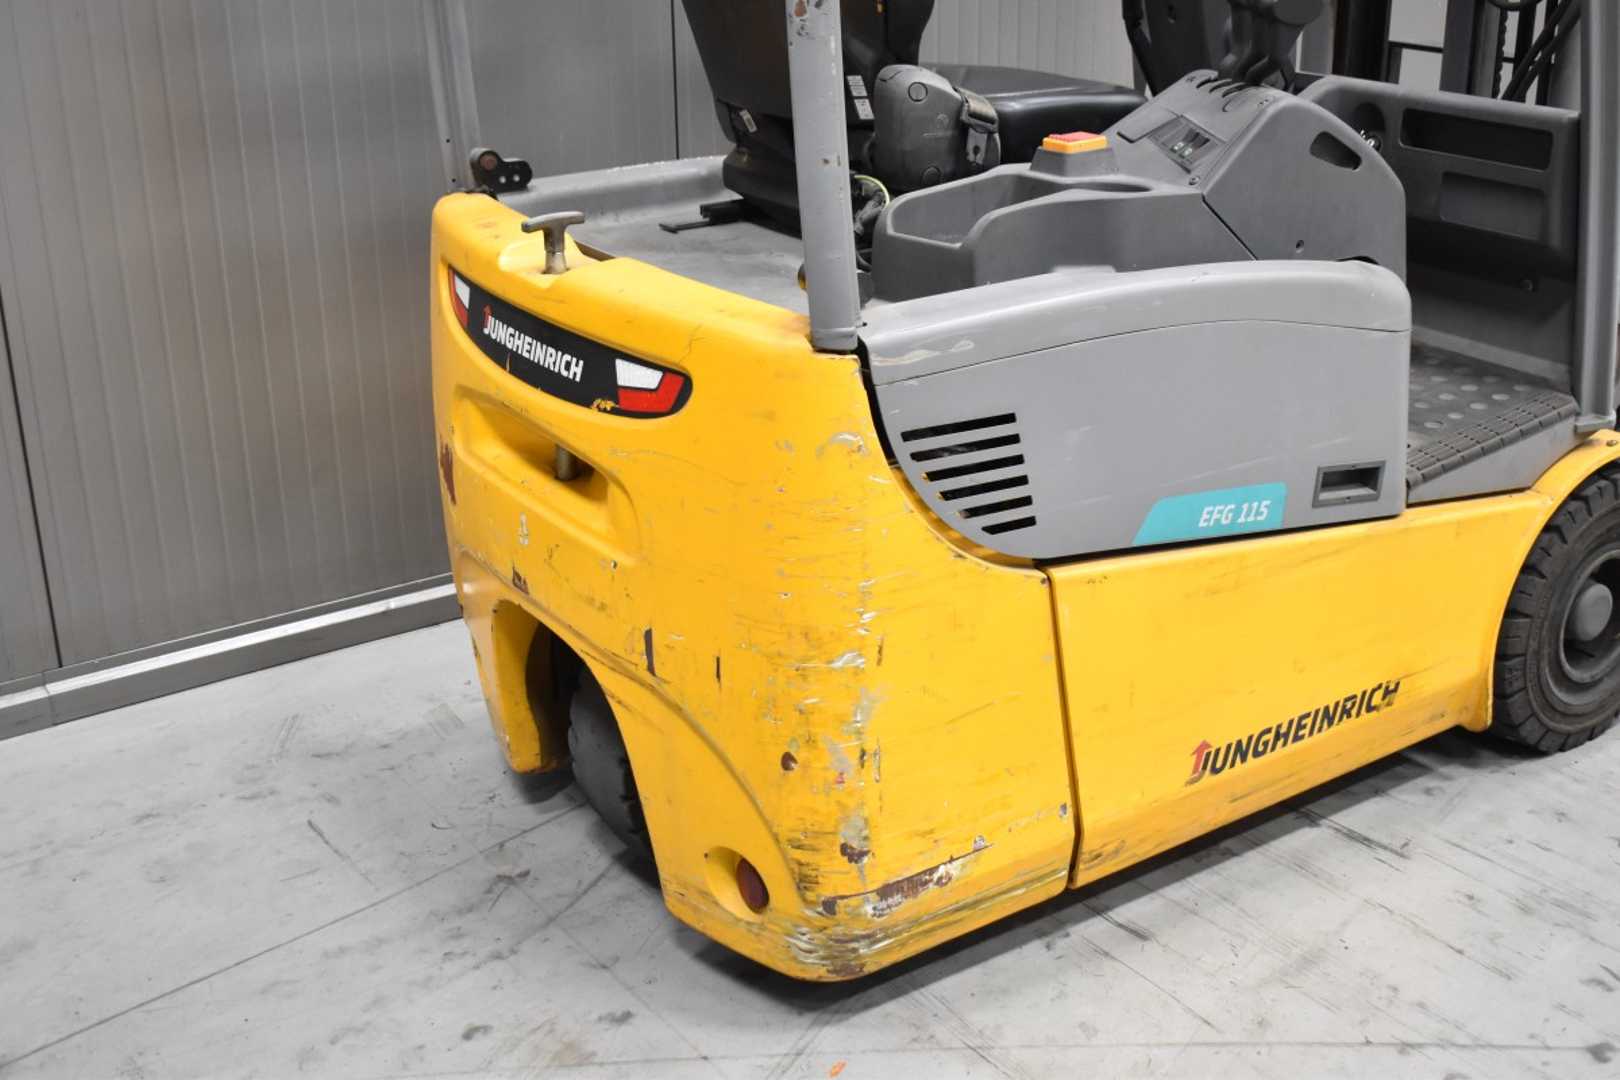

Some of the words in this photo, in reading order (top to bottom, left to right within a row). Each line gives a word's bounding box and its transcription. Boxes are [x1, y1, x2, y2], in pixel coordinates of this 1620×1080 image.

[483, 315, 584, 383] JUNGHEINRICH
[1198, 504, 1236, 528] EFG
[1237, 500, 1272, 524] 115
[1187, 681, 1400, 785] JUNGHEINRICH
